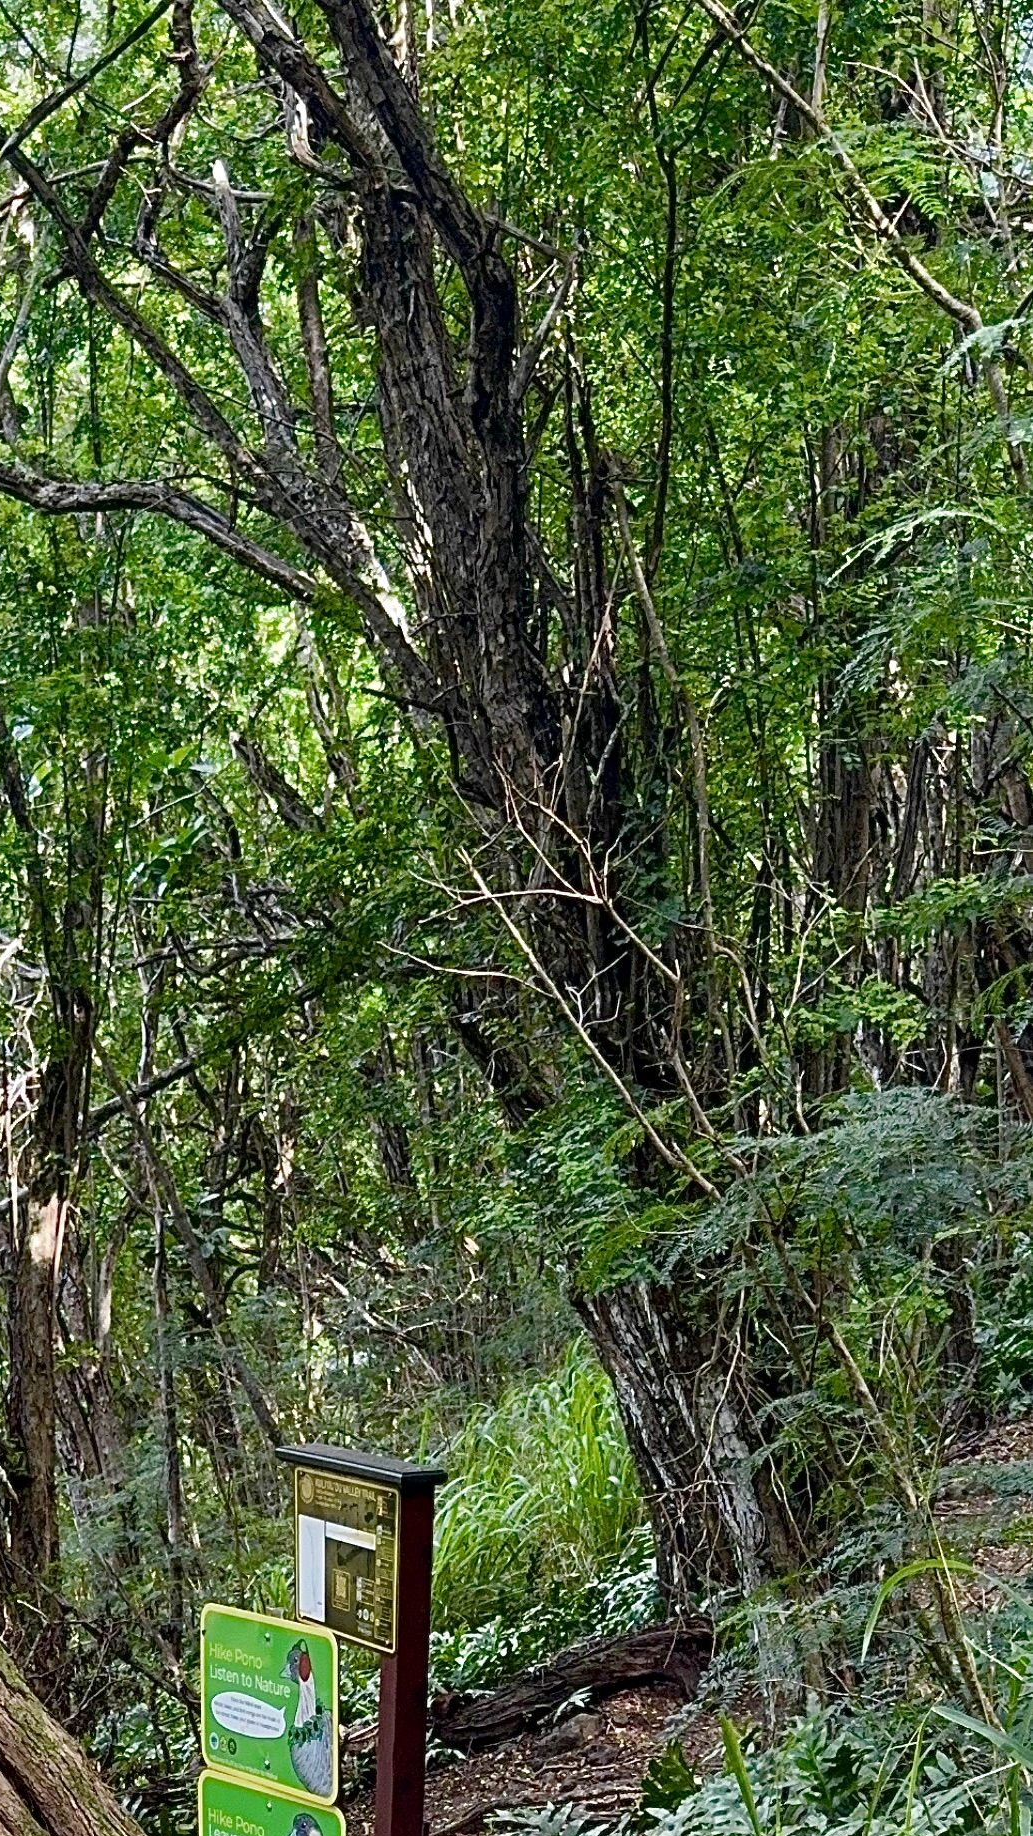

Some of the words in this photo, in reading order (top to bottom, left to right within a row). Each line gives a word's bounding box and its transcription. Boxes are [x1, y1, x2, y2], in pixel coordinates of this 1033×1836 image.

[209, 1643, 233, 1663] Hike
[234, 1649, 263, 1670] Pono
[209, 1665, 239, 1684] Listen
[241, 1673, 252, 1688] to
[255, 1675, 291, 1699] Nature
[208, 1808, 233, 1829] Hike
